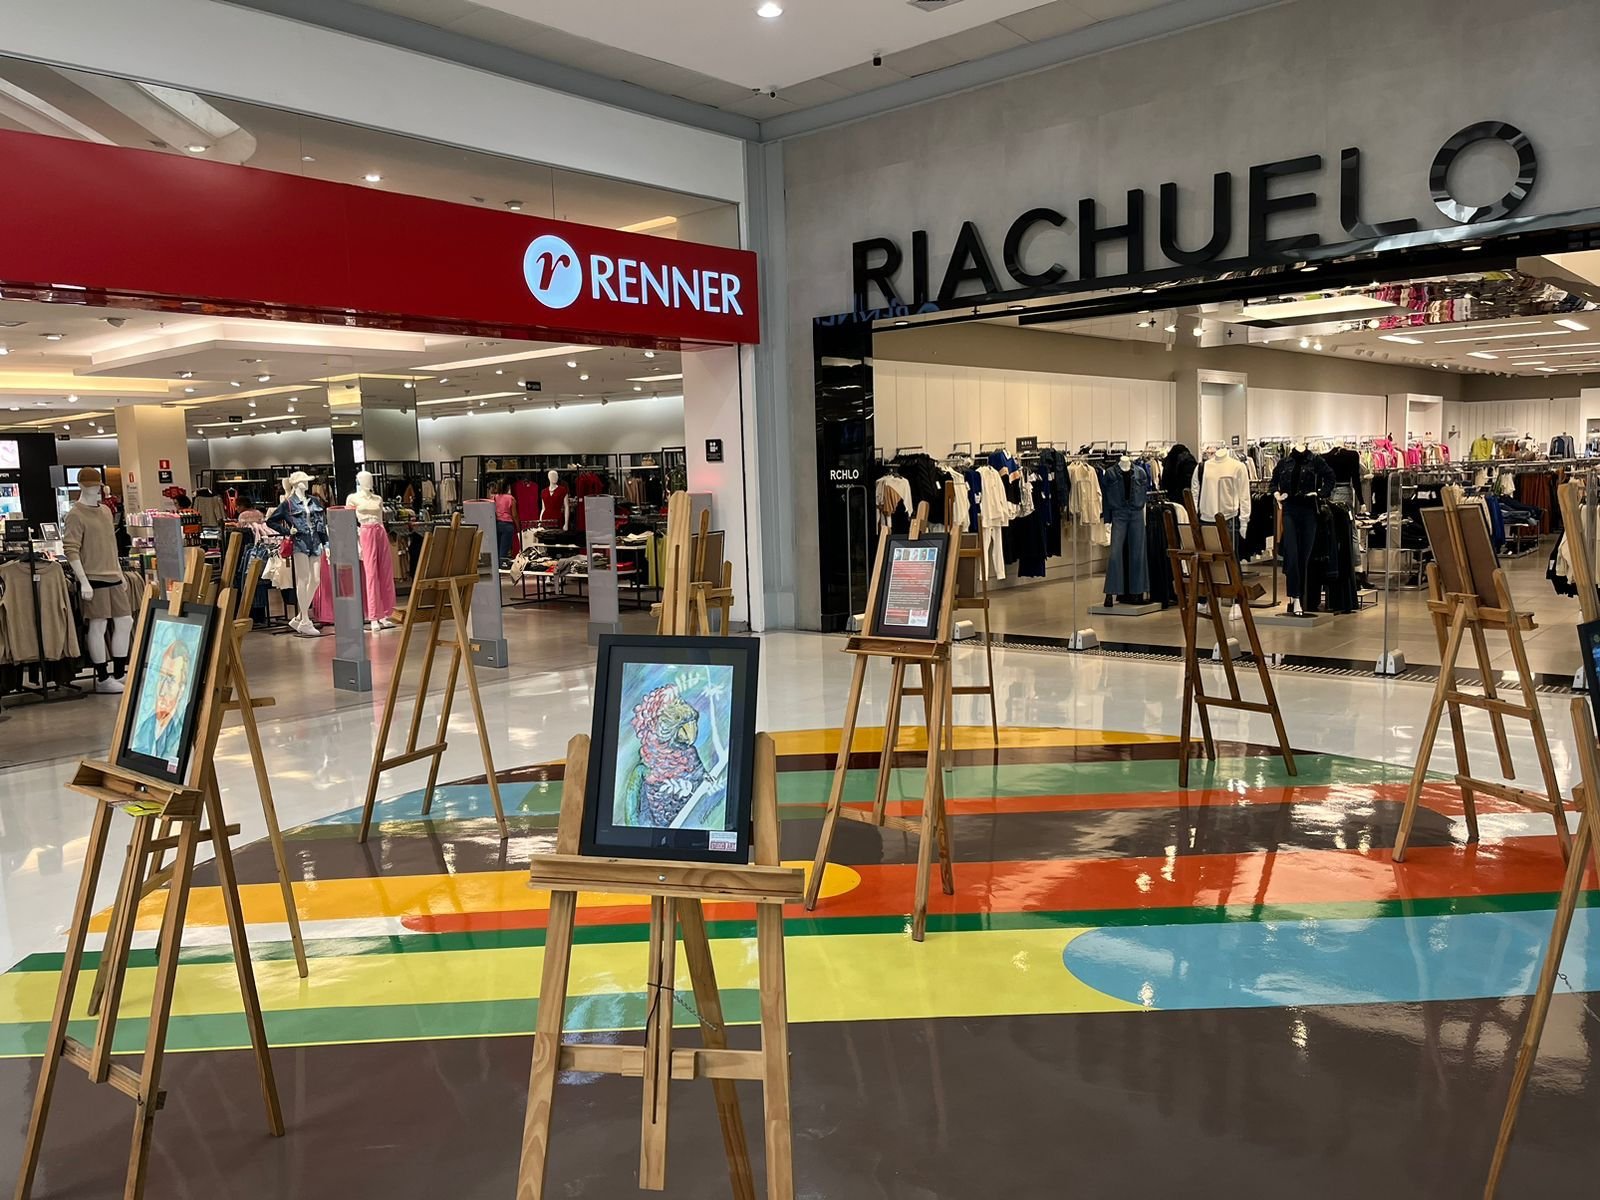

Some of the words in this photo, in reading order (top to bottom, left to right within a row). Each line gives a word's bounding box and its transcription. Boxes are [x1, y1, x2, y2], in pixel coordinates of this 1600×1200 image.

[853, 120, 1538, 311] RIACHUELO
[590, 254, 744, 316] RENNER
[830, 469, 860, 480] RCHLO
